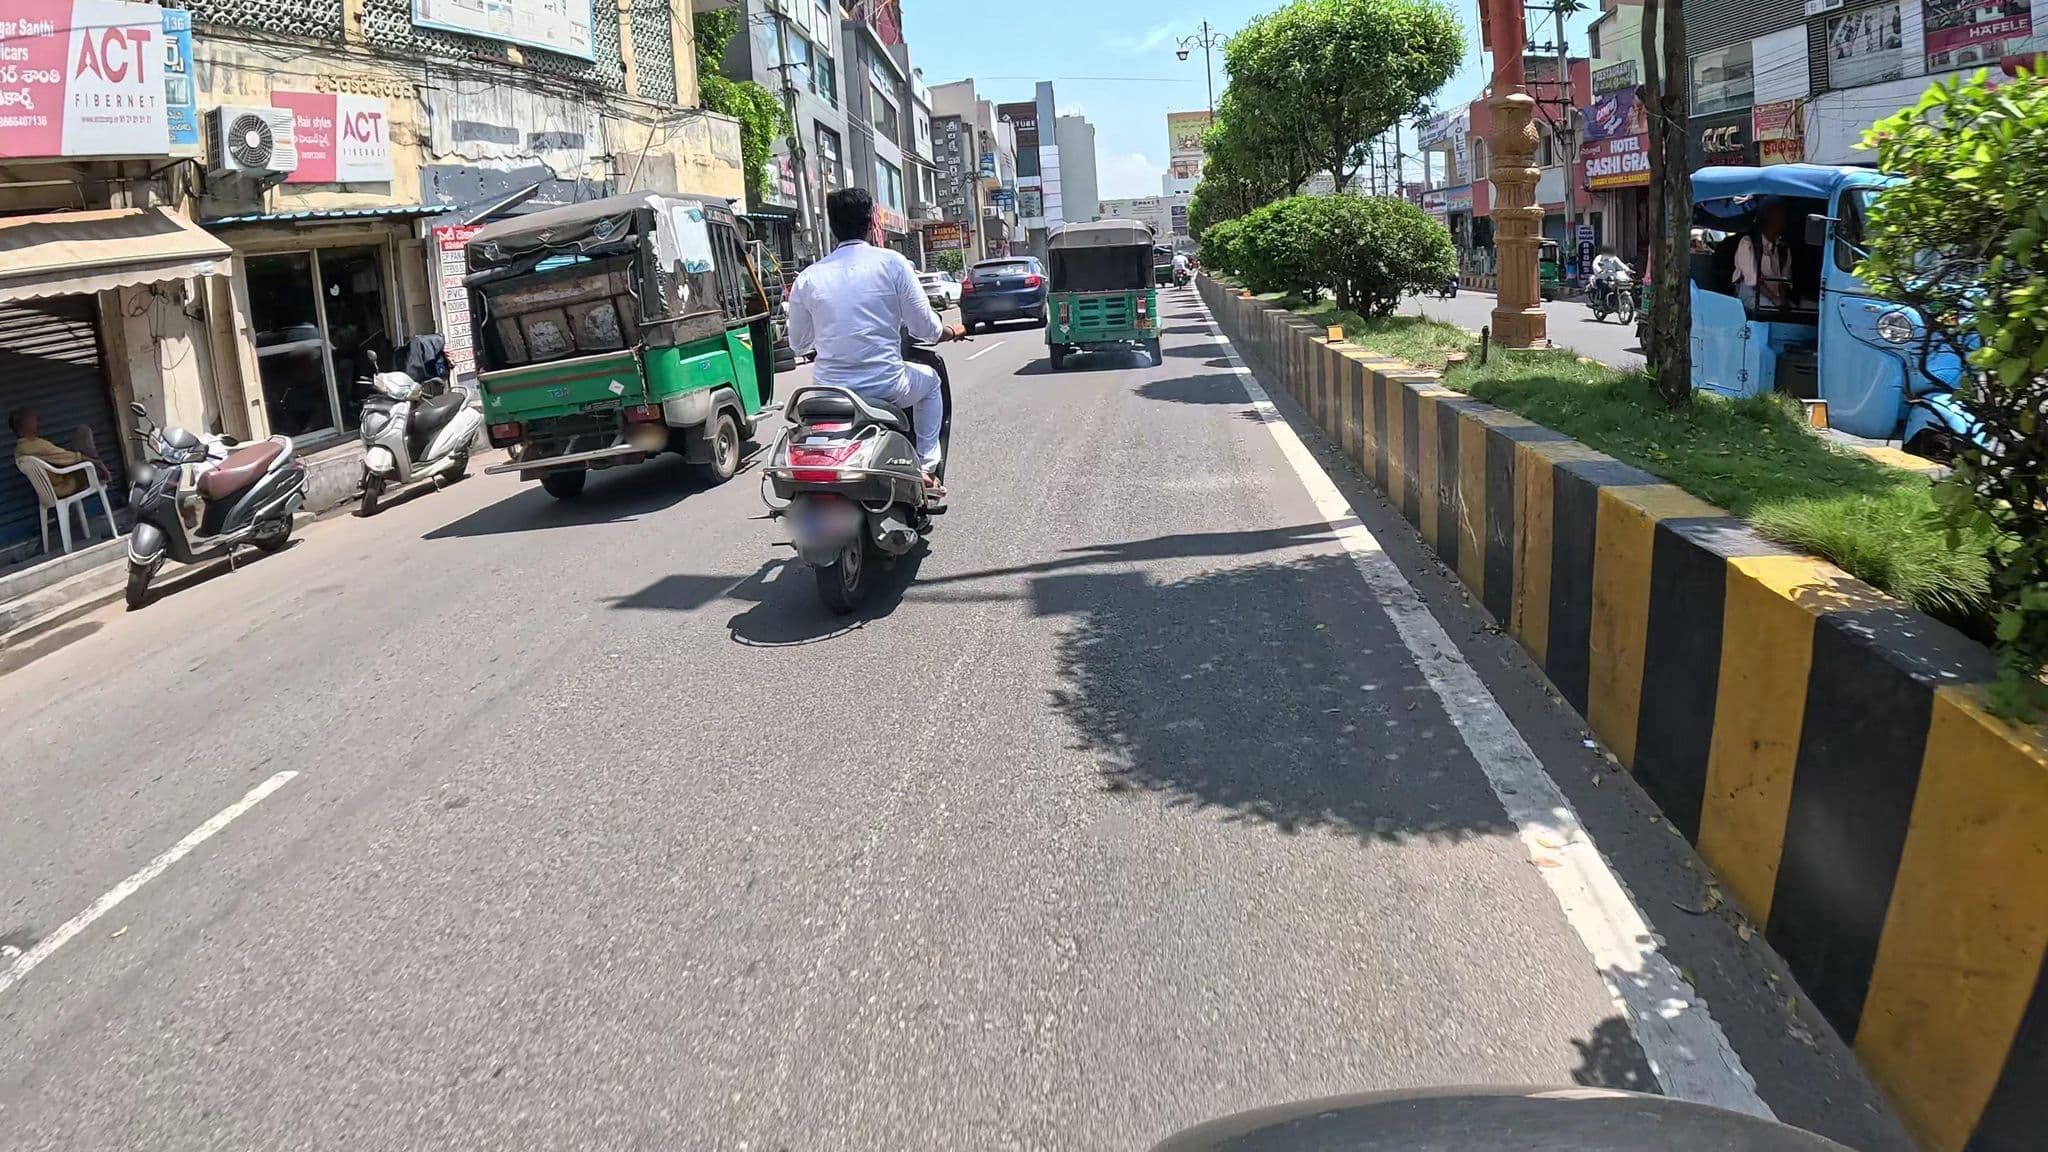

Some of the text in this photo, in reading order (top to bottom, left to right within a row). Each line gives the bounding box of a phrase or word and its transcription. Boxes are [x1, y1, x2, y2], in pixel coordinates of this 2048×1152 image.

[19, 18, 54, 37] Santhi
[74, 26, 151, 84] ACT
[75, 93, 155, 108] FIBERNET
[342, 111, 382, 143] ACT
[1610, 136, 1640, 155] HOTEL
[1585, 155, 1621, 177] SASHI
